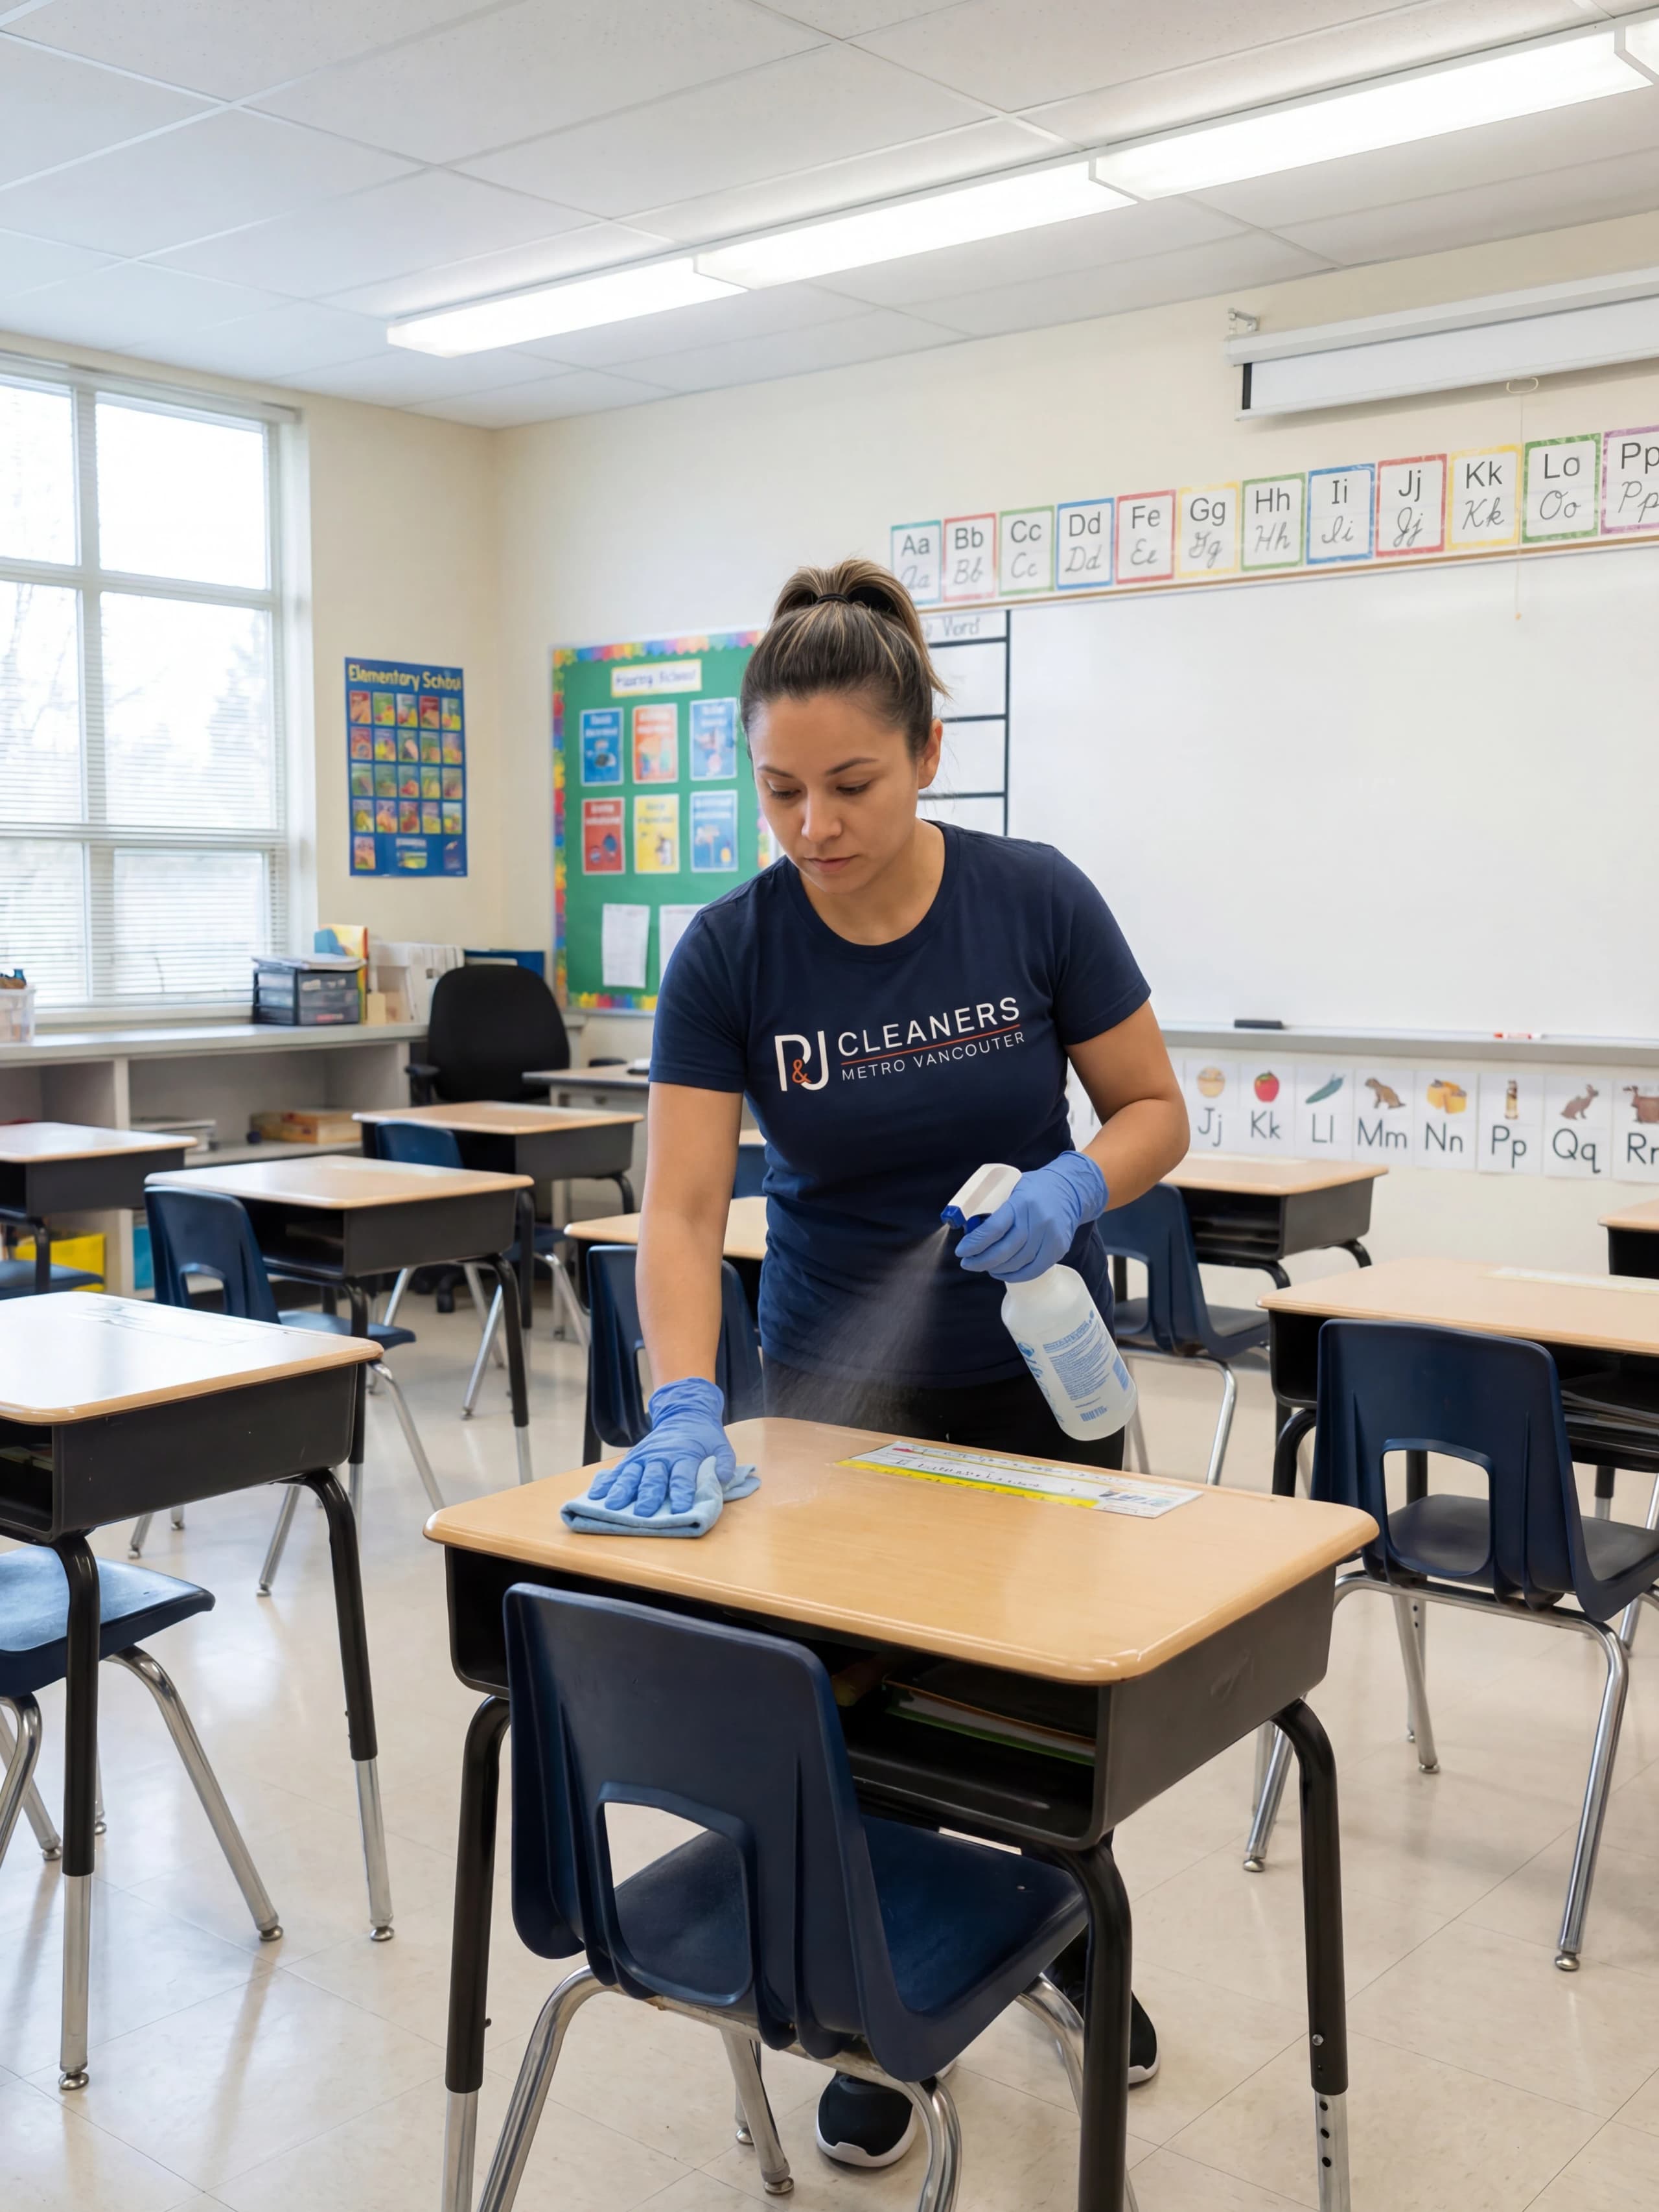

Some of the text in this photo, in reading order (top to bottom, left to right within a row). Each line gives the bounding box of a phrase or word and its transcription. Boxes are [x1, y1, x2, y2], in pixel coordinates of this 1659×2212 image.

[901, 534, 931, 557] Aa
[955, 526, 984, 550] Bb
[1010, 520, 1041, 544] Cc
[1069, 511, 1101, 537] Dd
[1189, 497, 1225, 527] Gg
[1255, 487, 1290, 514] Hh
[1398, 469, 1422, 502] Jj
[1466, 461, 1503, 489] Kk
[1621, 442, 1659, 474] Pp
[1064, 544, 1102, 573] Dd
[1254, 521, 1291, 552] Hh
[1462, 496, 1505, 530] Kk
[1539, 489, 1582, 520] Oo
[838, 997, 1021, 1056] CLEANERS
[842, 1032, 1025, 1081] METRO VANCOUTER
[1197, 1106, 1222, 1148] Jj
[1251, 1110, 1281, 1139] Kk
[1358, 1117, 1408, 1149] Mm
[1425, 1122, 1463, 1153] Nn
[1491, 1124, 1527, 1169] Pp
[1552, 1128, 1601, 1174] Qq
